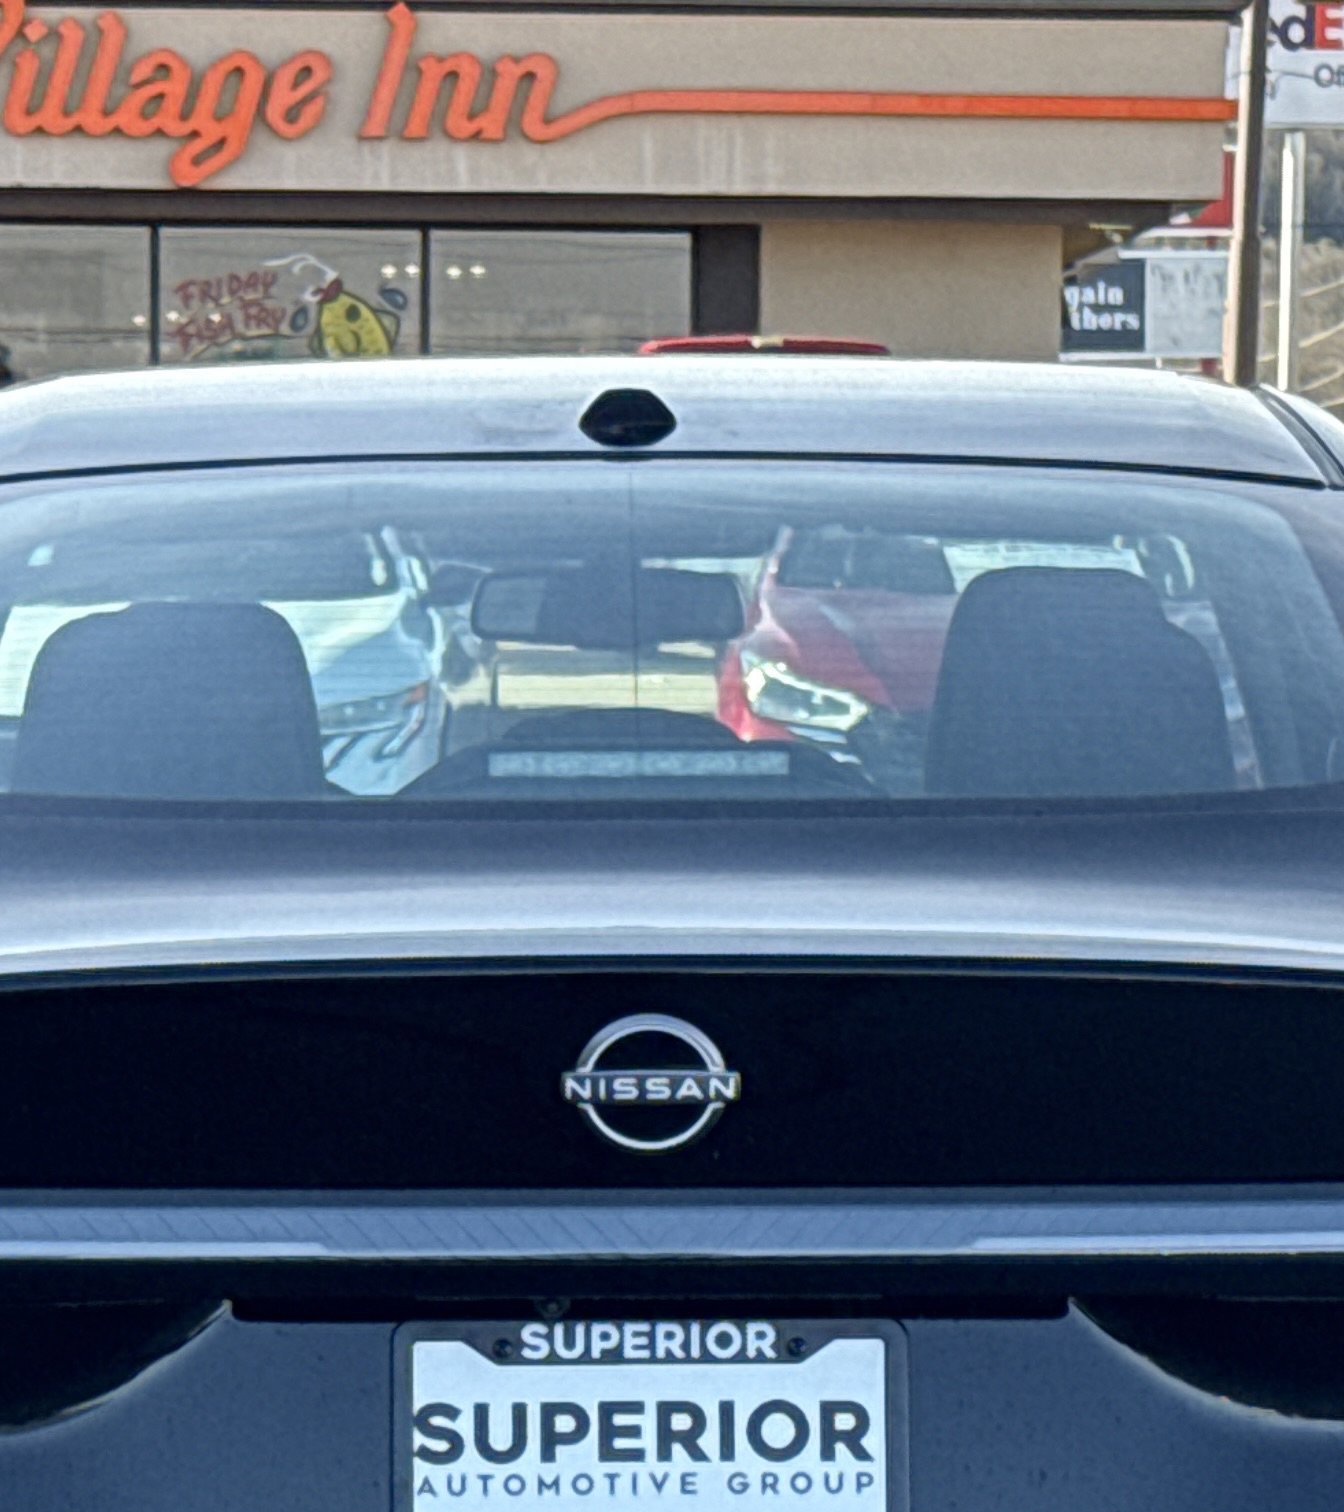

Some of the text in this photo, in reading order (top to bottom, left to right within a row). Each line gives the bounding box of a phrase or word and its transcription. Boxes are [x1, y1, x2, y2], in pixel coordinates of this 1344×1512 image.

[359, 2, 562, 143] Inn
[173, 271, 278, 308] FRIDAY
[240, 299, 288, 332] FRY
[564, 1077, 736, 1101] NISSAN
[520, 1322, 779, 1360] SUPERIOR
[414, 1399, 875, 1466] SUPERIOR
[417, 1471, 875, 1498] AUTOMOTIVE GROUP
